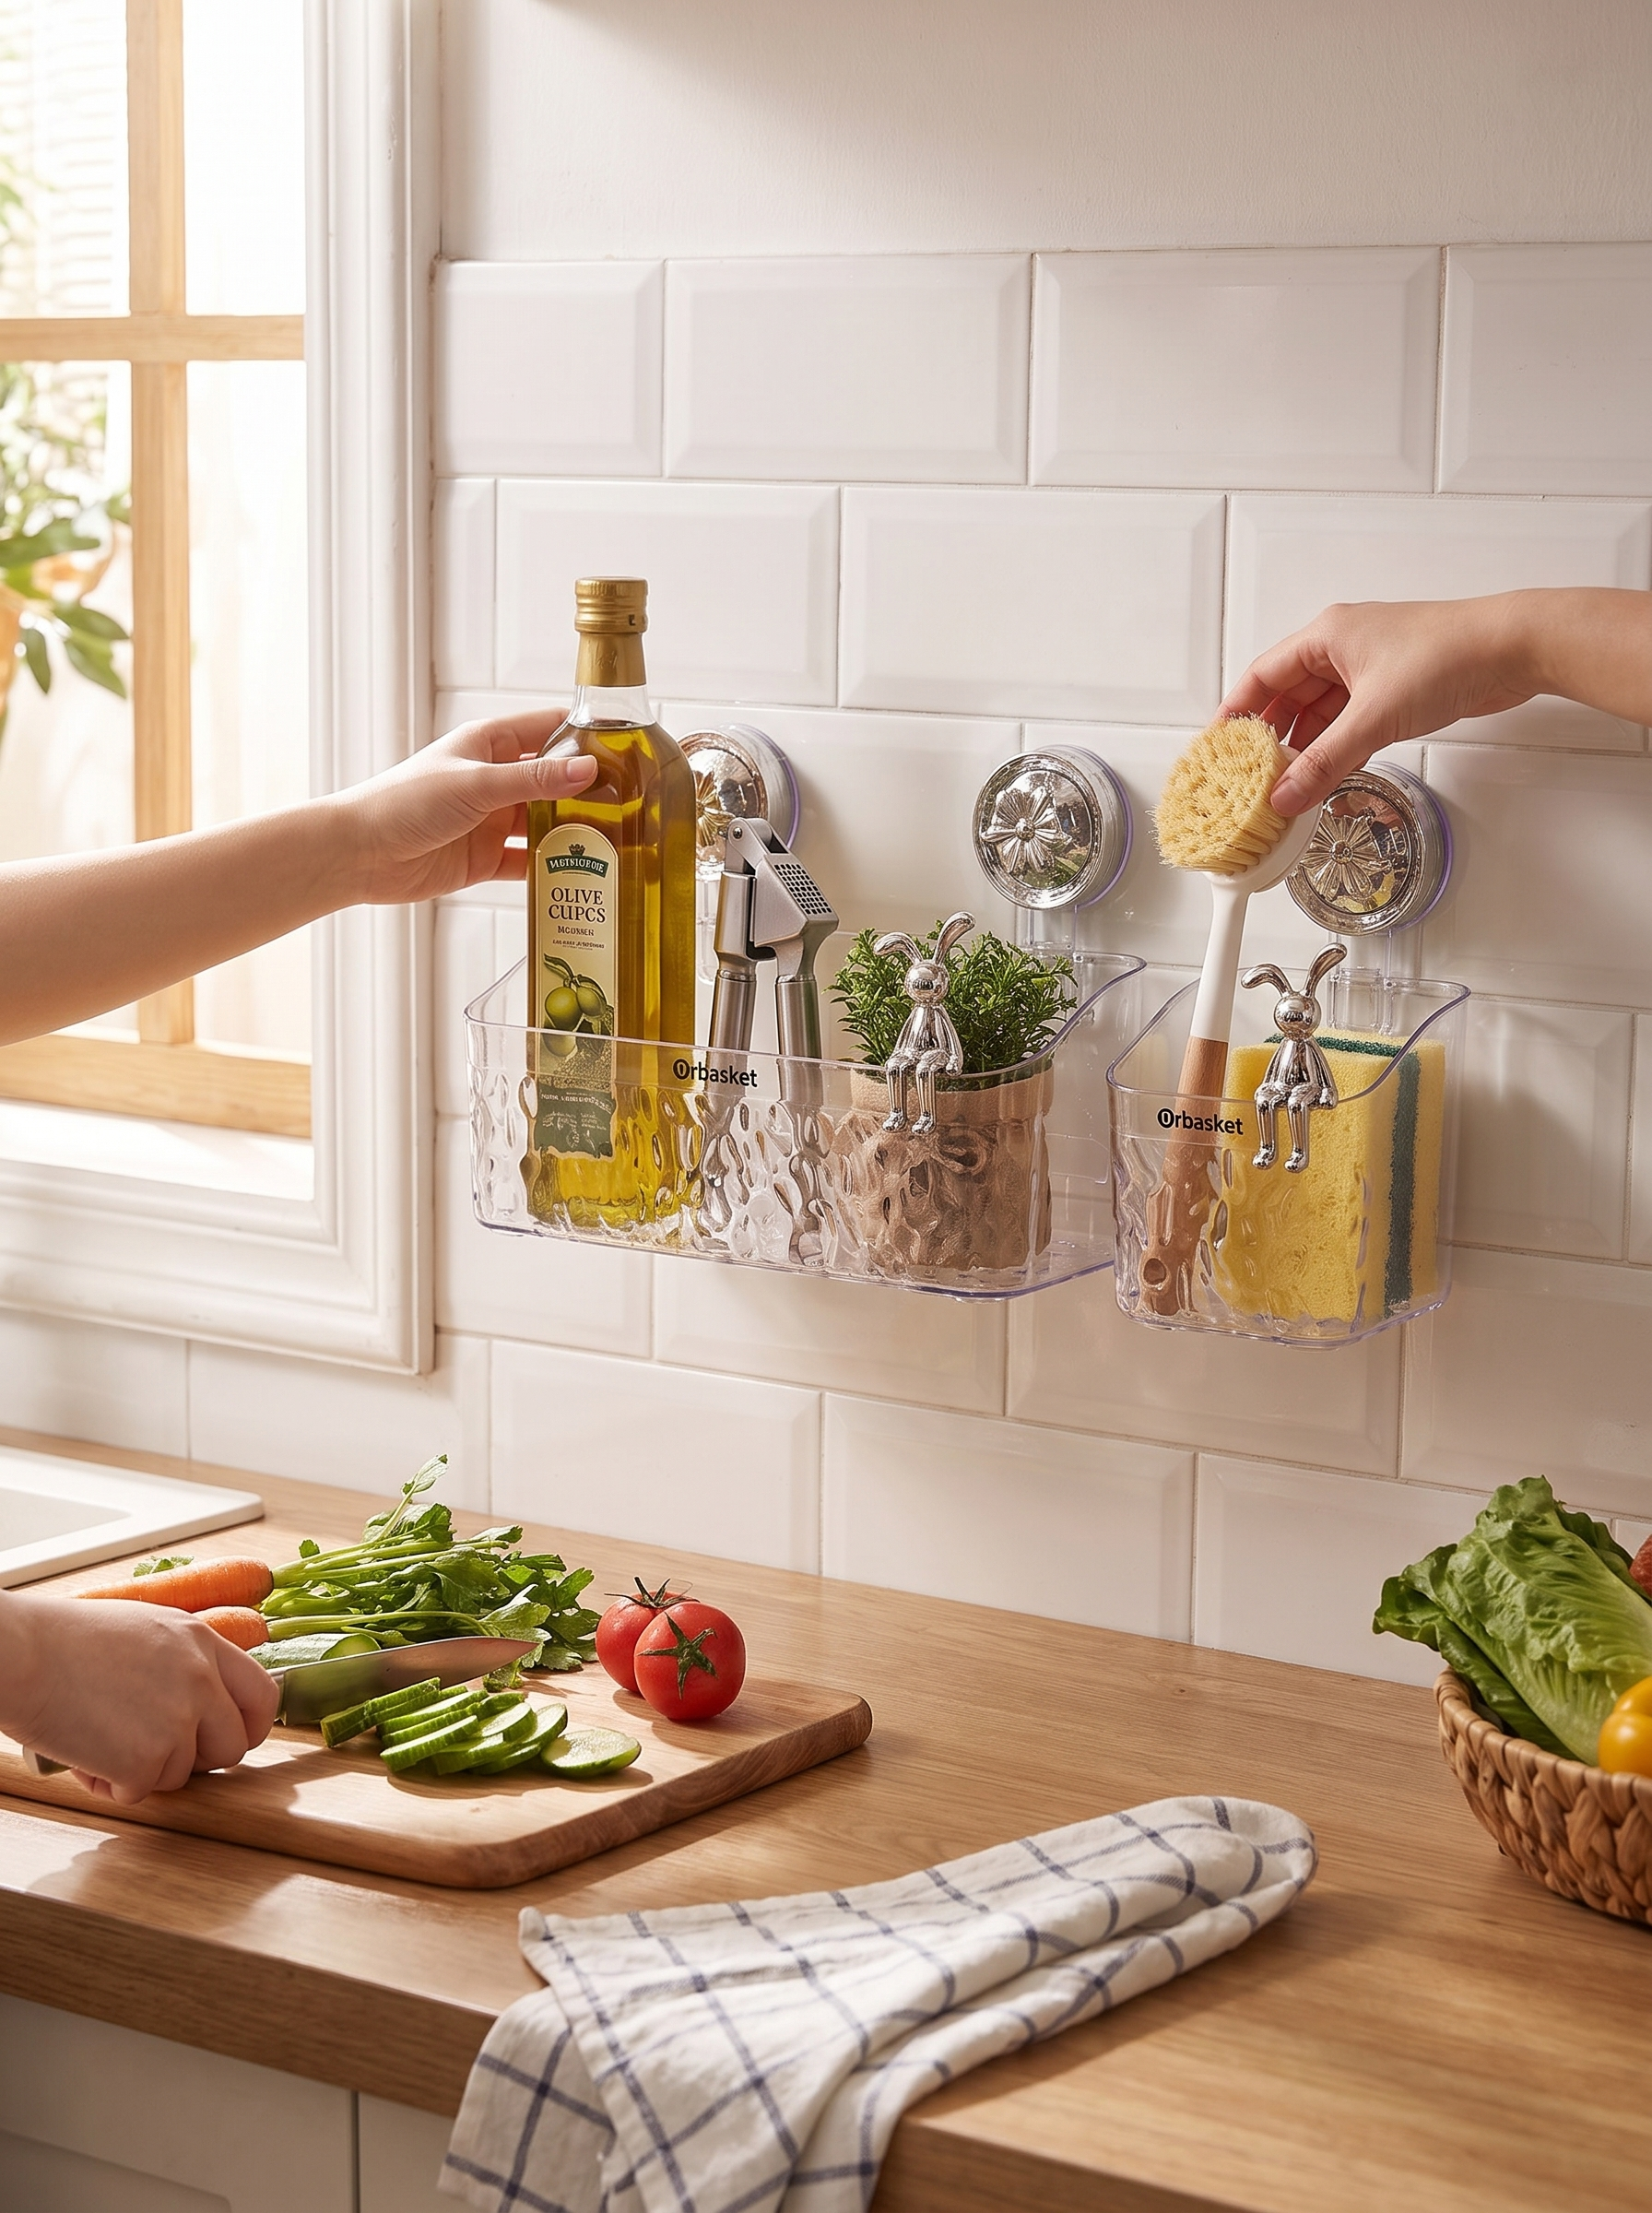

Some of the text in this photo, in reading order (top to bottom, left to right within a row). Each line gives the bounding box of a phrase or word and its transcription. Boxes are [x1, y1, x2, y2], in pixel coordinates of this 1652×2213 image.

[550, 887, 603, 905] OLIVE
[672, 1058, 758, 1088] Orbasket
[1157, 1107, 1244, 1135] Orbasket
